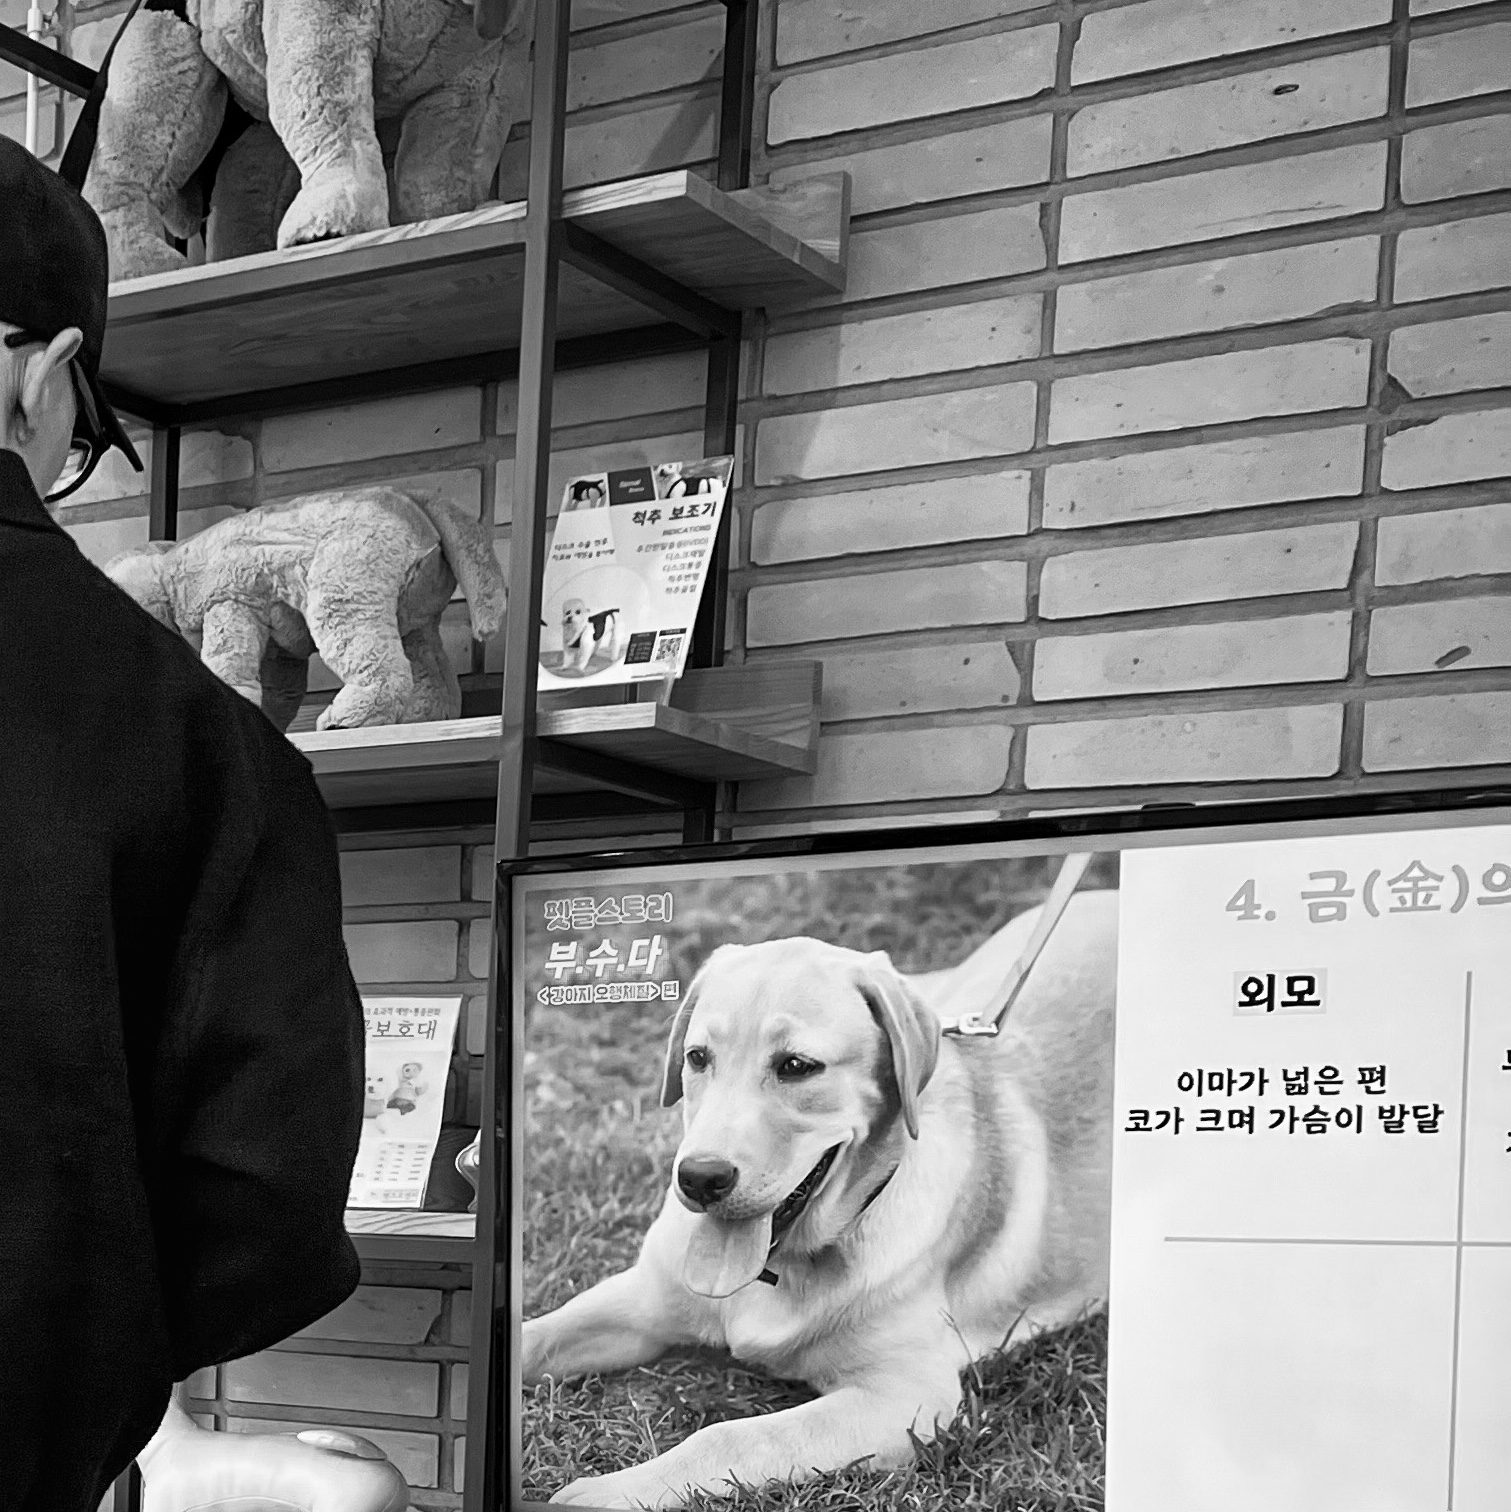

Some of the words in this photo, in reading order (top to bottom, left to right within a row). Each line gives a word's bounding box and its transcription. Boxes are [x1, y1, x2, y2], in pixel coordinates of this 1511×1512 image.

[632, 509, 662, 526] 척추
[669, 501, 717, 520] 보조기
[1226, 879, 1276, 922] 4.
[545, 935, 663, 979] 부.수.다
[1237, 973, 1321, 1012] 외모
[1177, 1067, 1270, 1098] 이마가
[1282, 1065, 1344, 1097] 넓은
[1357, 1064, 1387, 1096] 편
[1124, 1106, 1185, 1135] 코가
[1196, 1105, 1256, 1135] 크며
[1268, 1104, 1364, 1135] 가슴이
[1378, 1103, 1445, 1135] 발달
